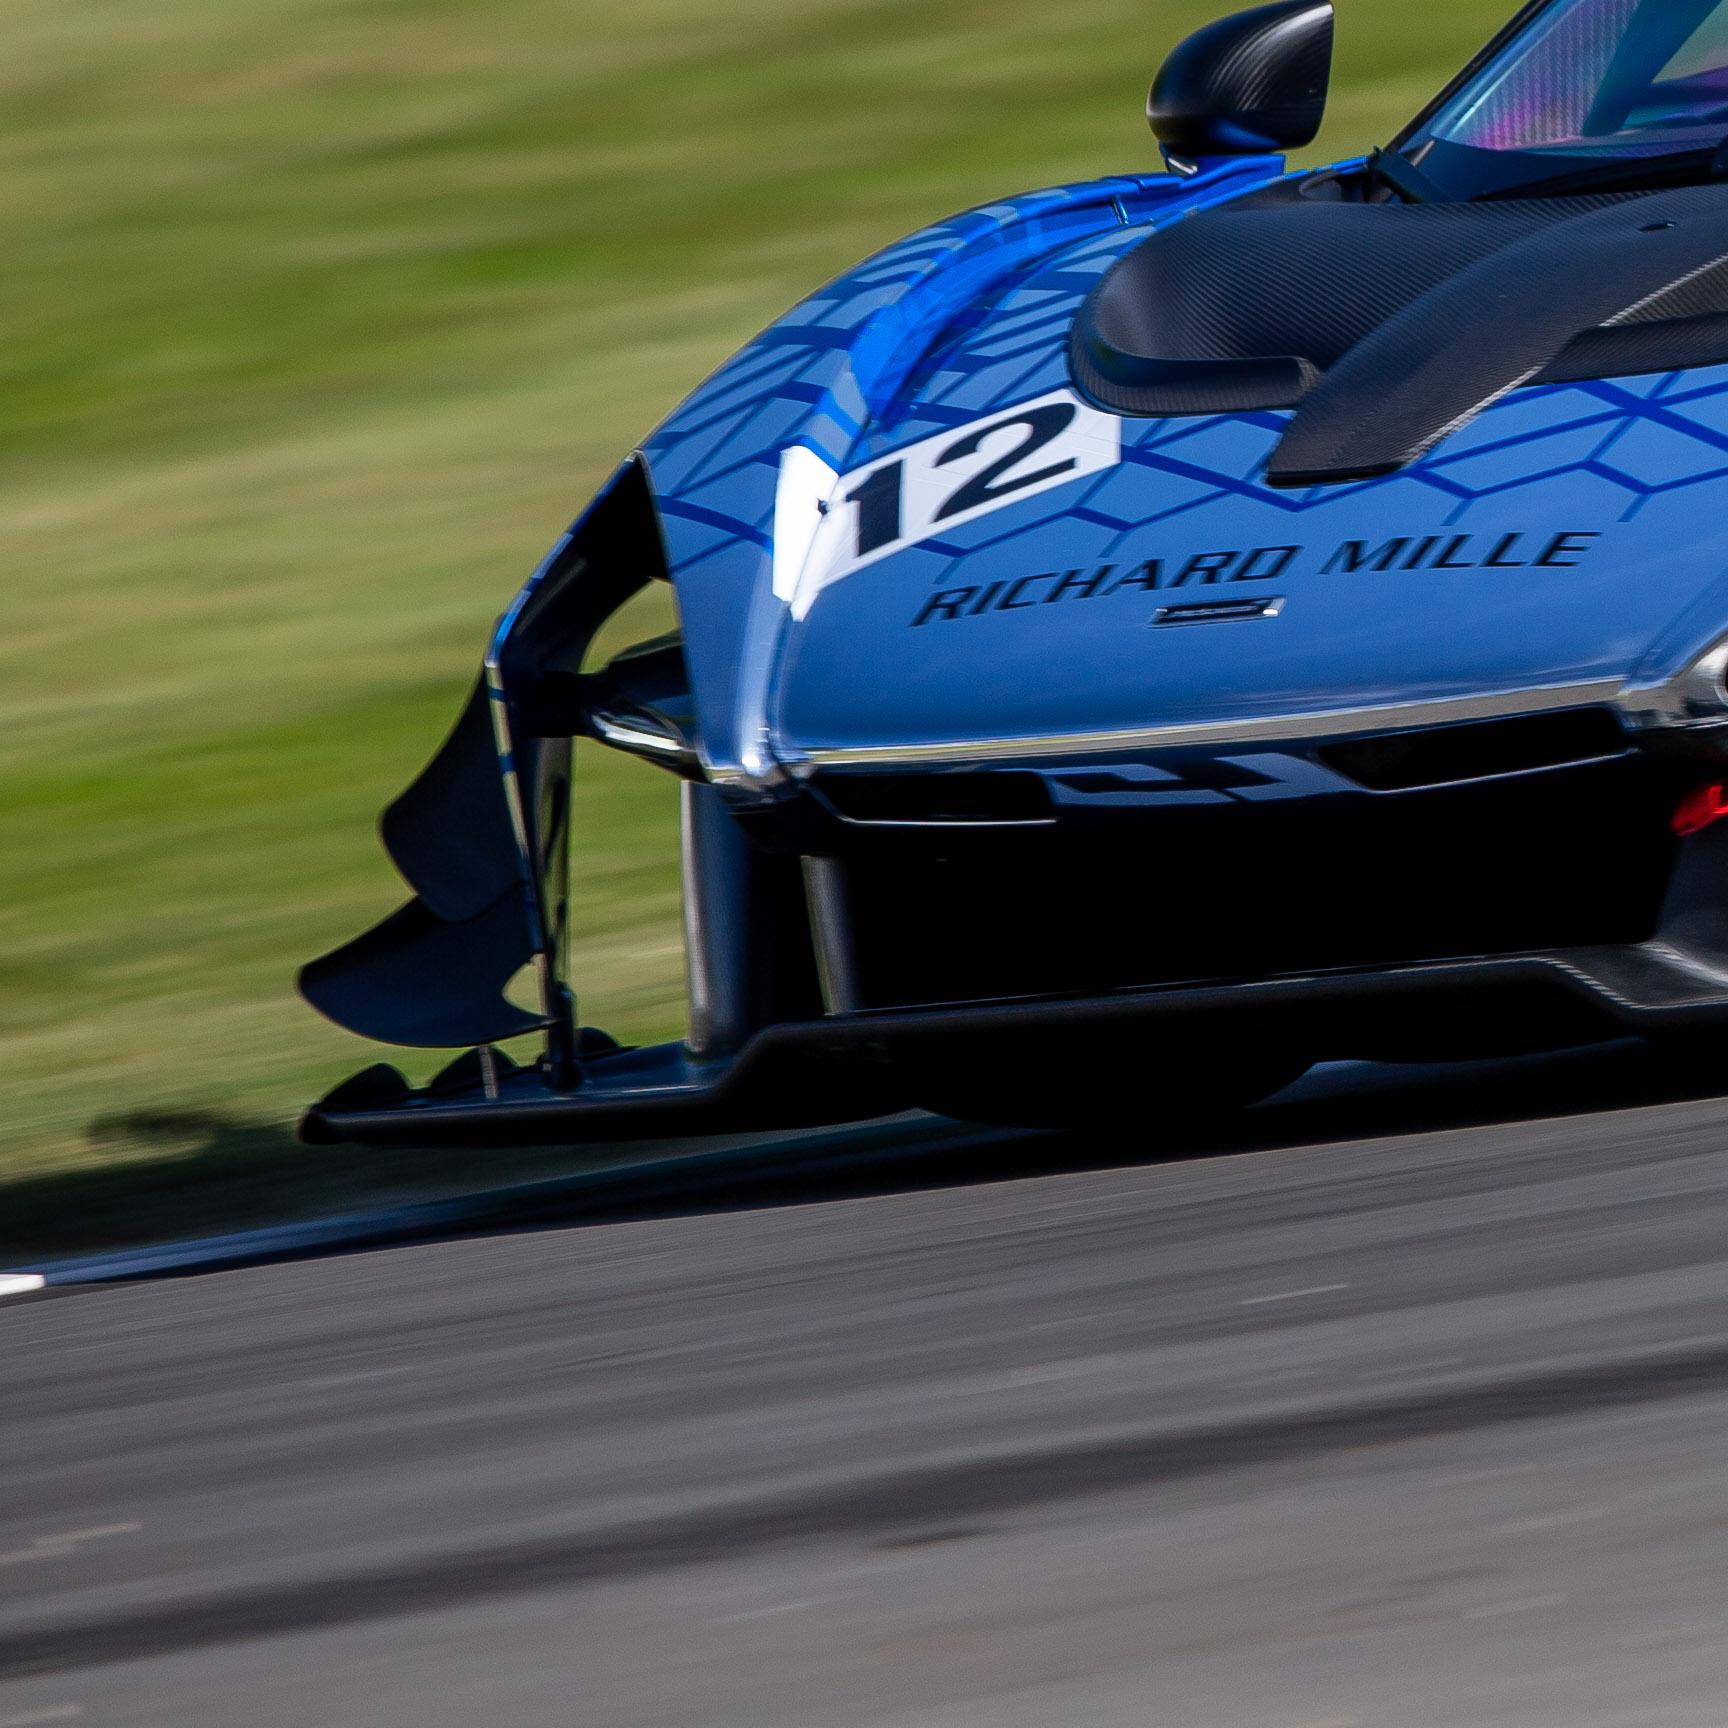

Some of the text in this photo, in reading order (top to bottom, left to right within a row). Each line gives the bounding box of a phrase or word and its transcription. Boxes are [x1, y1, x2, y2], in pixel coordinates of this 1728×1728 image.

[846, 400, 1078, 557] 12
[910, 529, 1602, 628] RICHARD MILLE
